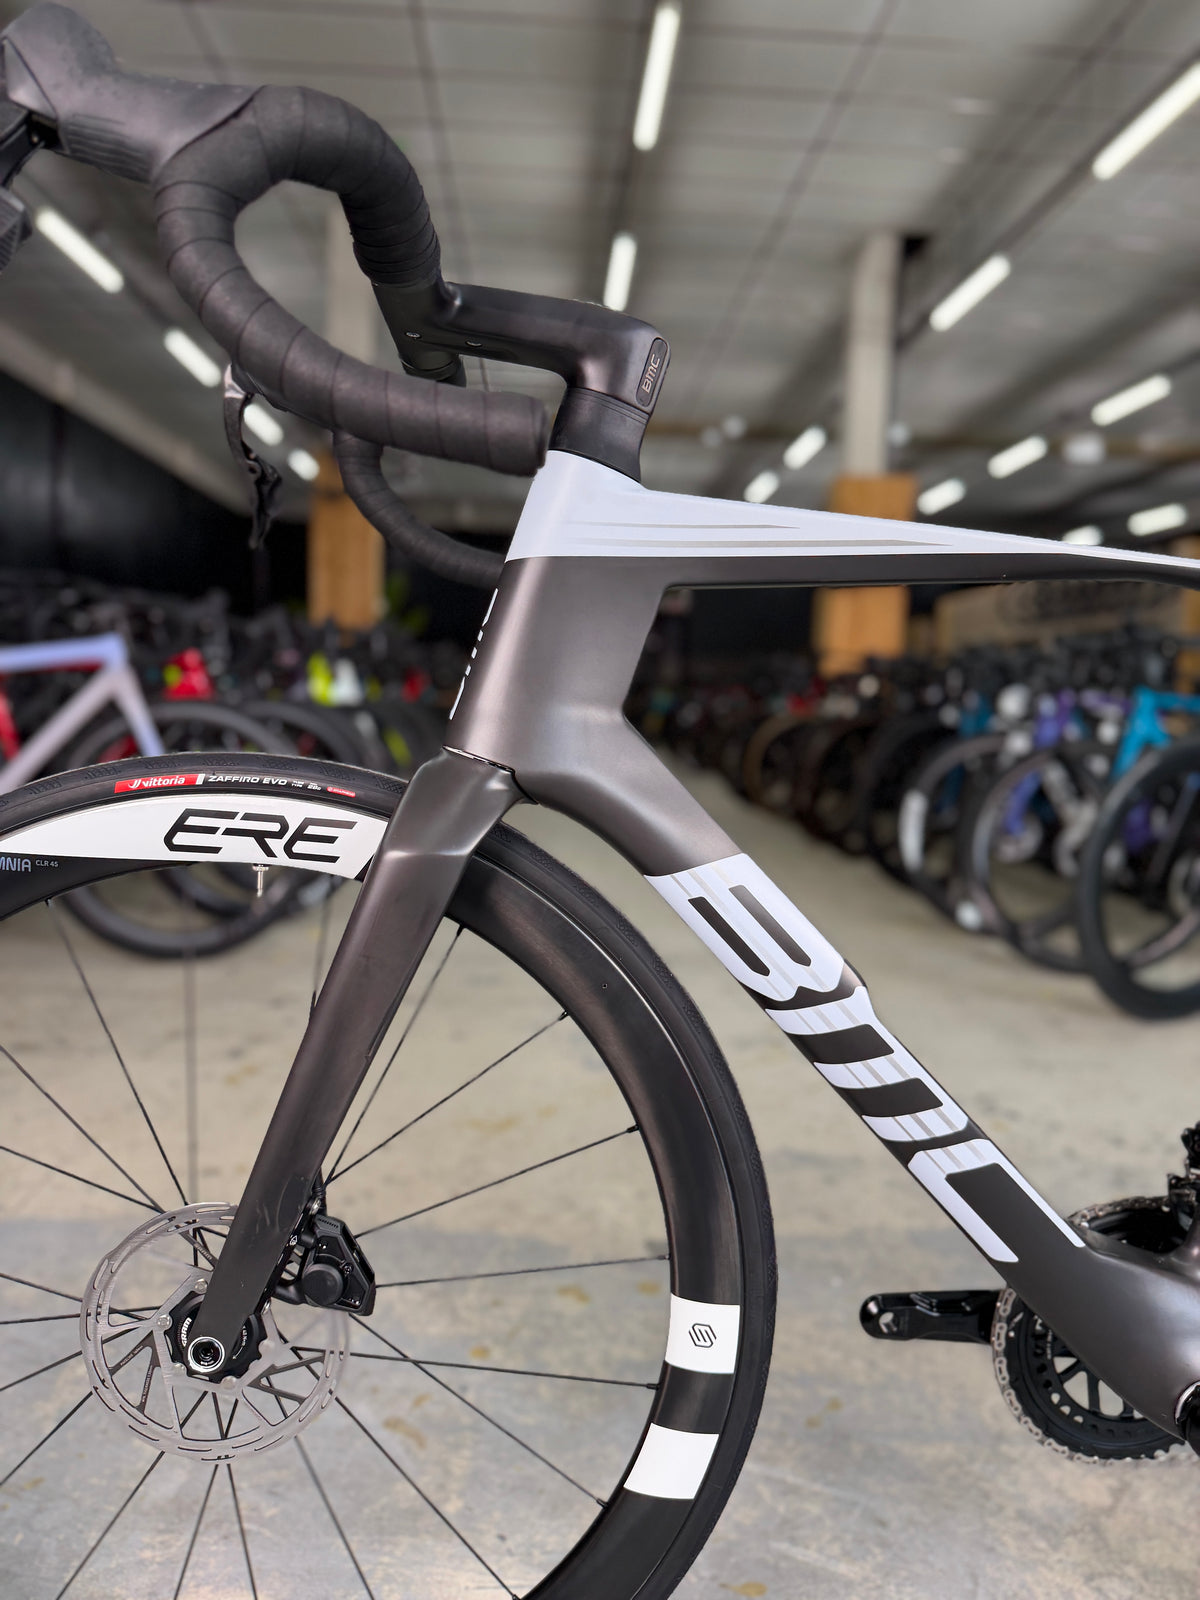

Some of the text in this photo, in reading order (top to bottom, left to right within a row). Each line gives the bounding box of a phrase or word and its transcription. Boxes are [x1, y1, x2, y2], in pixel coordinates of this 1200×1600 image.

[642, 353, 660, 393] BMC
[142, 774, 288, 787] vittoria ZAFFIRO EVO
[163, 807, 358, 864] ERE
[35, 859, 49, 867] CLR
[643, 852, 1087, 1263] BMC
